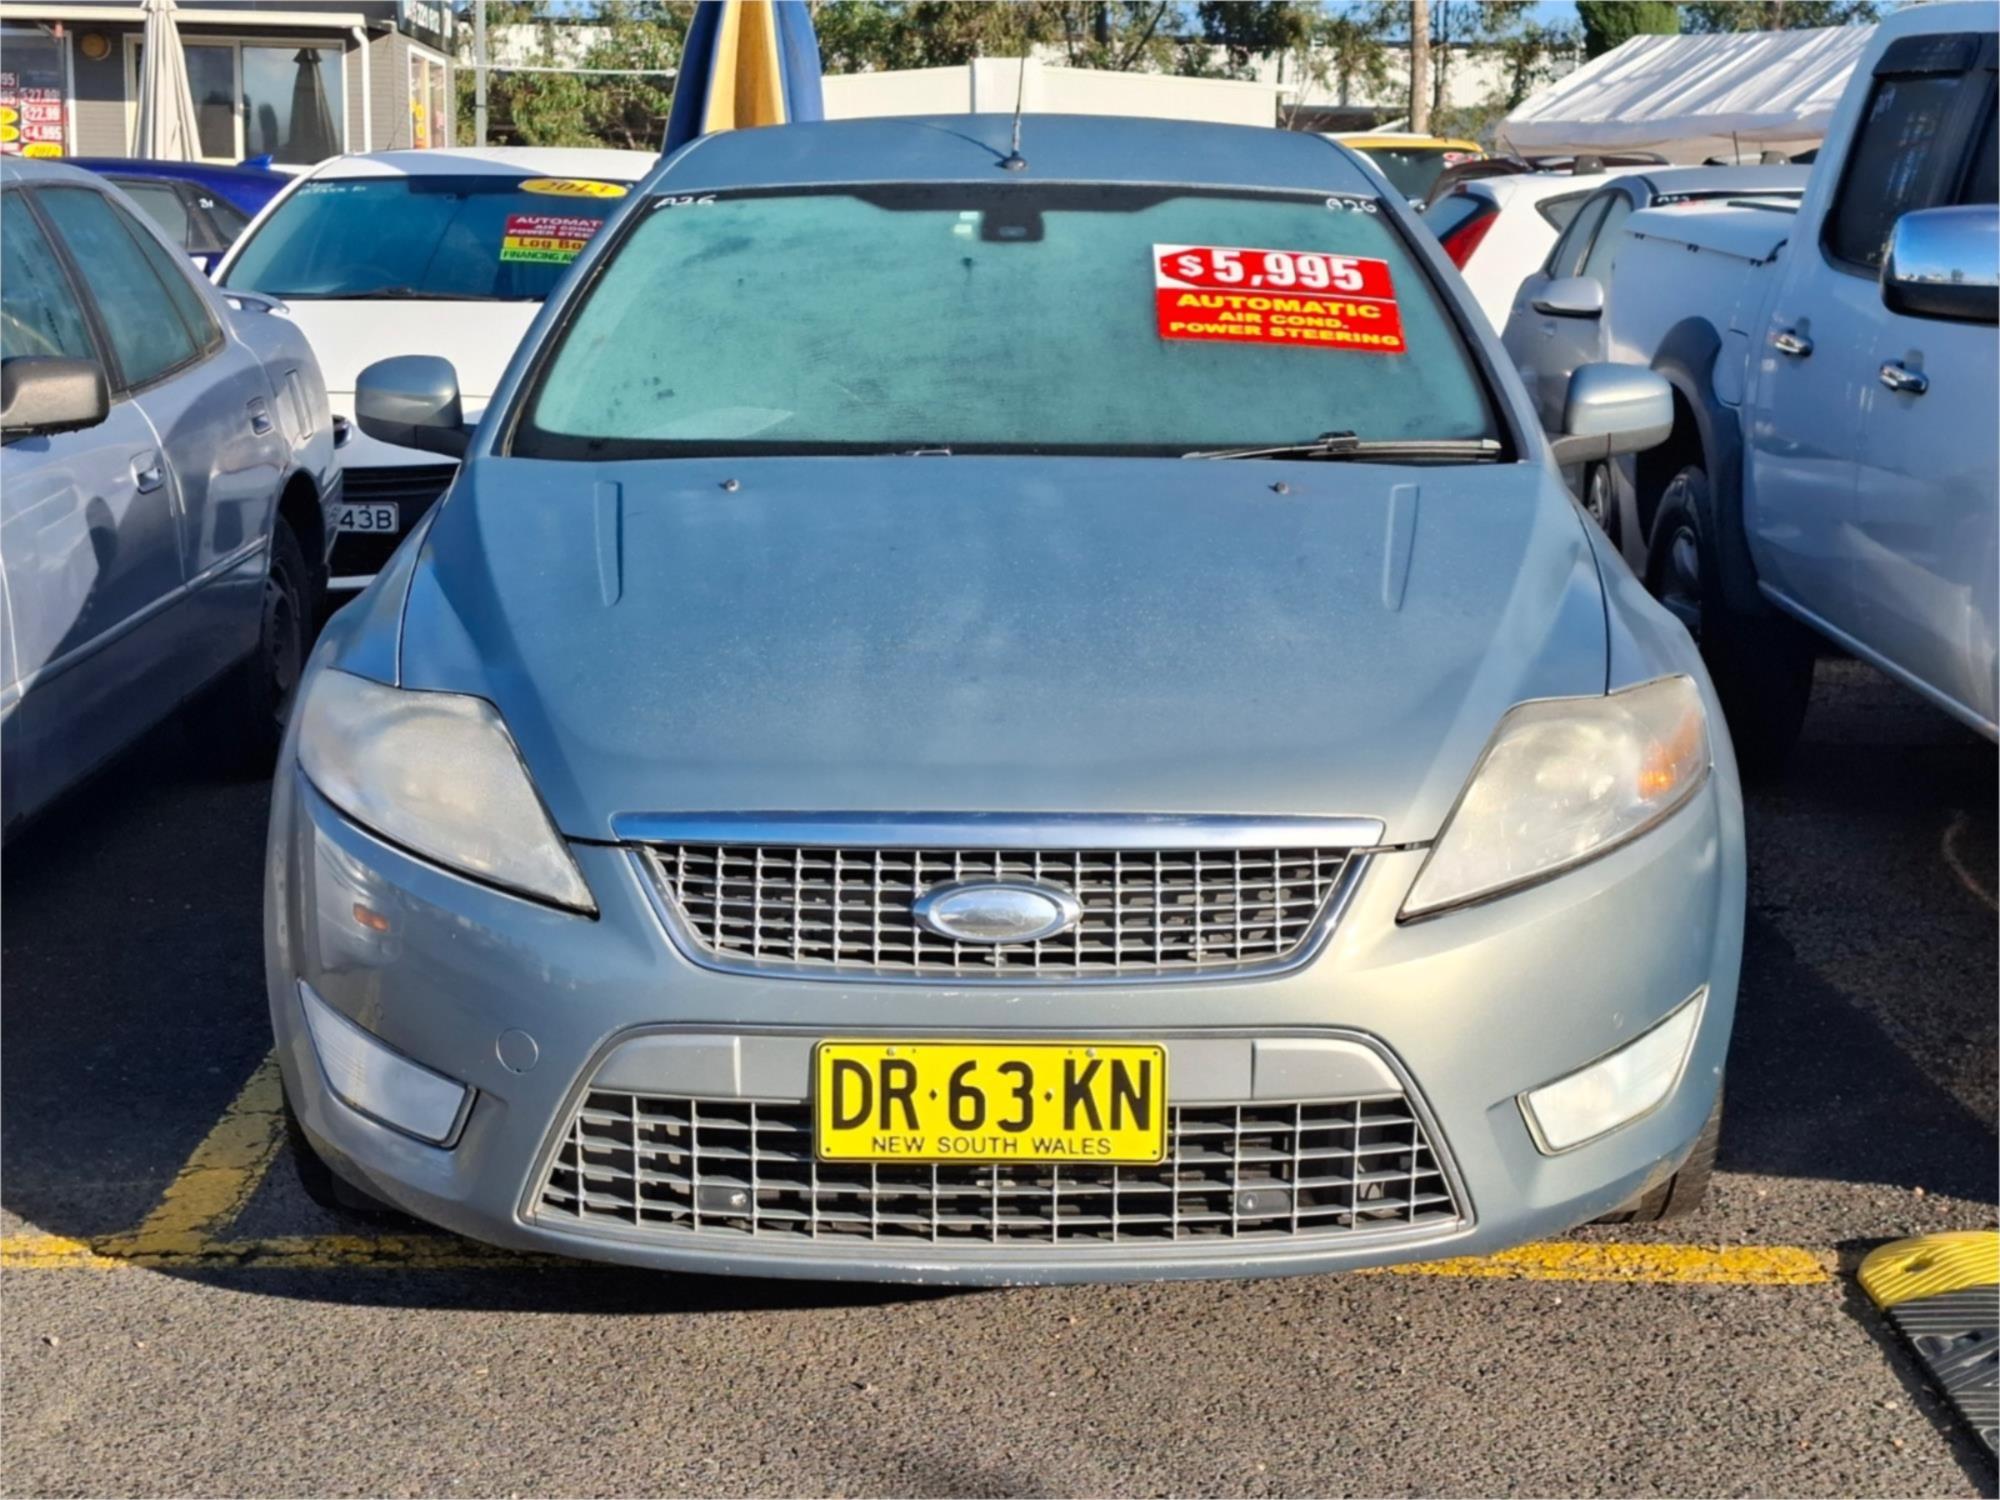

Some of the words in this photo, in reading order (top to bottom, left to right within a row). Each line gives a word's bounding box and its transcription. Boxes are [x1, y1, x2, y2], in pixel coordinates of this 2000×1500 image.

[518, 238, 552, 250] Log
[504, 250, 560, 261] FINANCING
[1177, 250, 1364, 291] $5,995
[1177, 293, 1382, 318] AUTOMATIC
[1218, 311, 1262, 324] AIR
[1270, 315, 1349, 329] COND.
[1170, 322, 1262, 336] POWER
[1269, 326, 1400, 346] STEERING
[872, 1136, 925, 1154] NEW
[937, 1136, 1018, 1154] SOUTH
[1032, 1136, 1112, 1155] WALES
